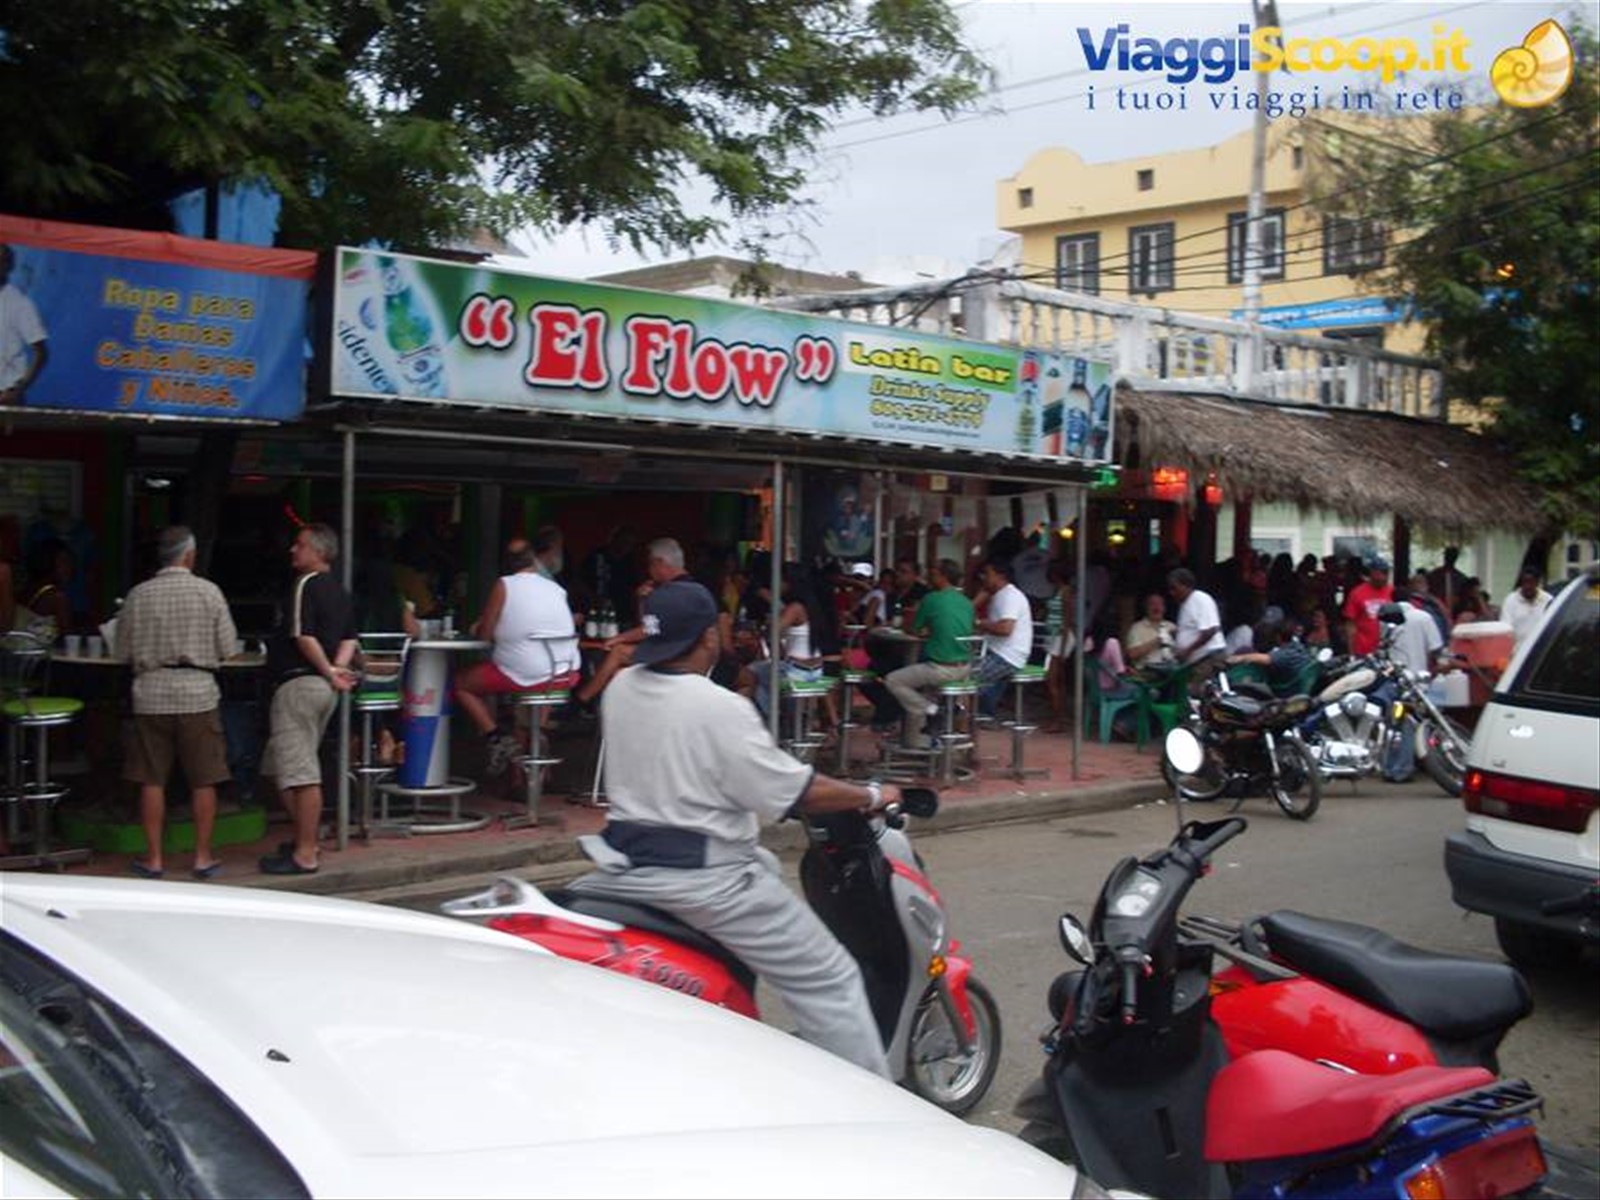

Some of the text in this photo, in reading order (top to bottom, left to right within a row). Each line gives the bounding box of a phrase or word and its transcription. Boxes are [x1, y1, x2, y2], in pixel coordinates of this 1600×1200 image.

[104, 279, 256, 320] Ropa para
[133, 313, 234, 348] Damas
[96, 341, 257, 379] Caballeros
[848, 341, 1011, 386] Latin bar
